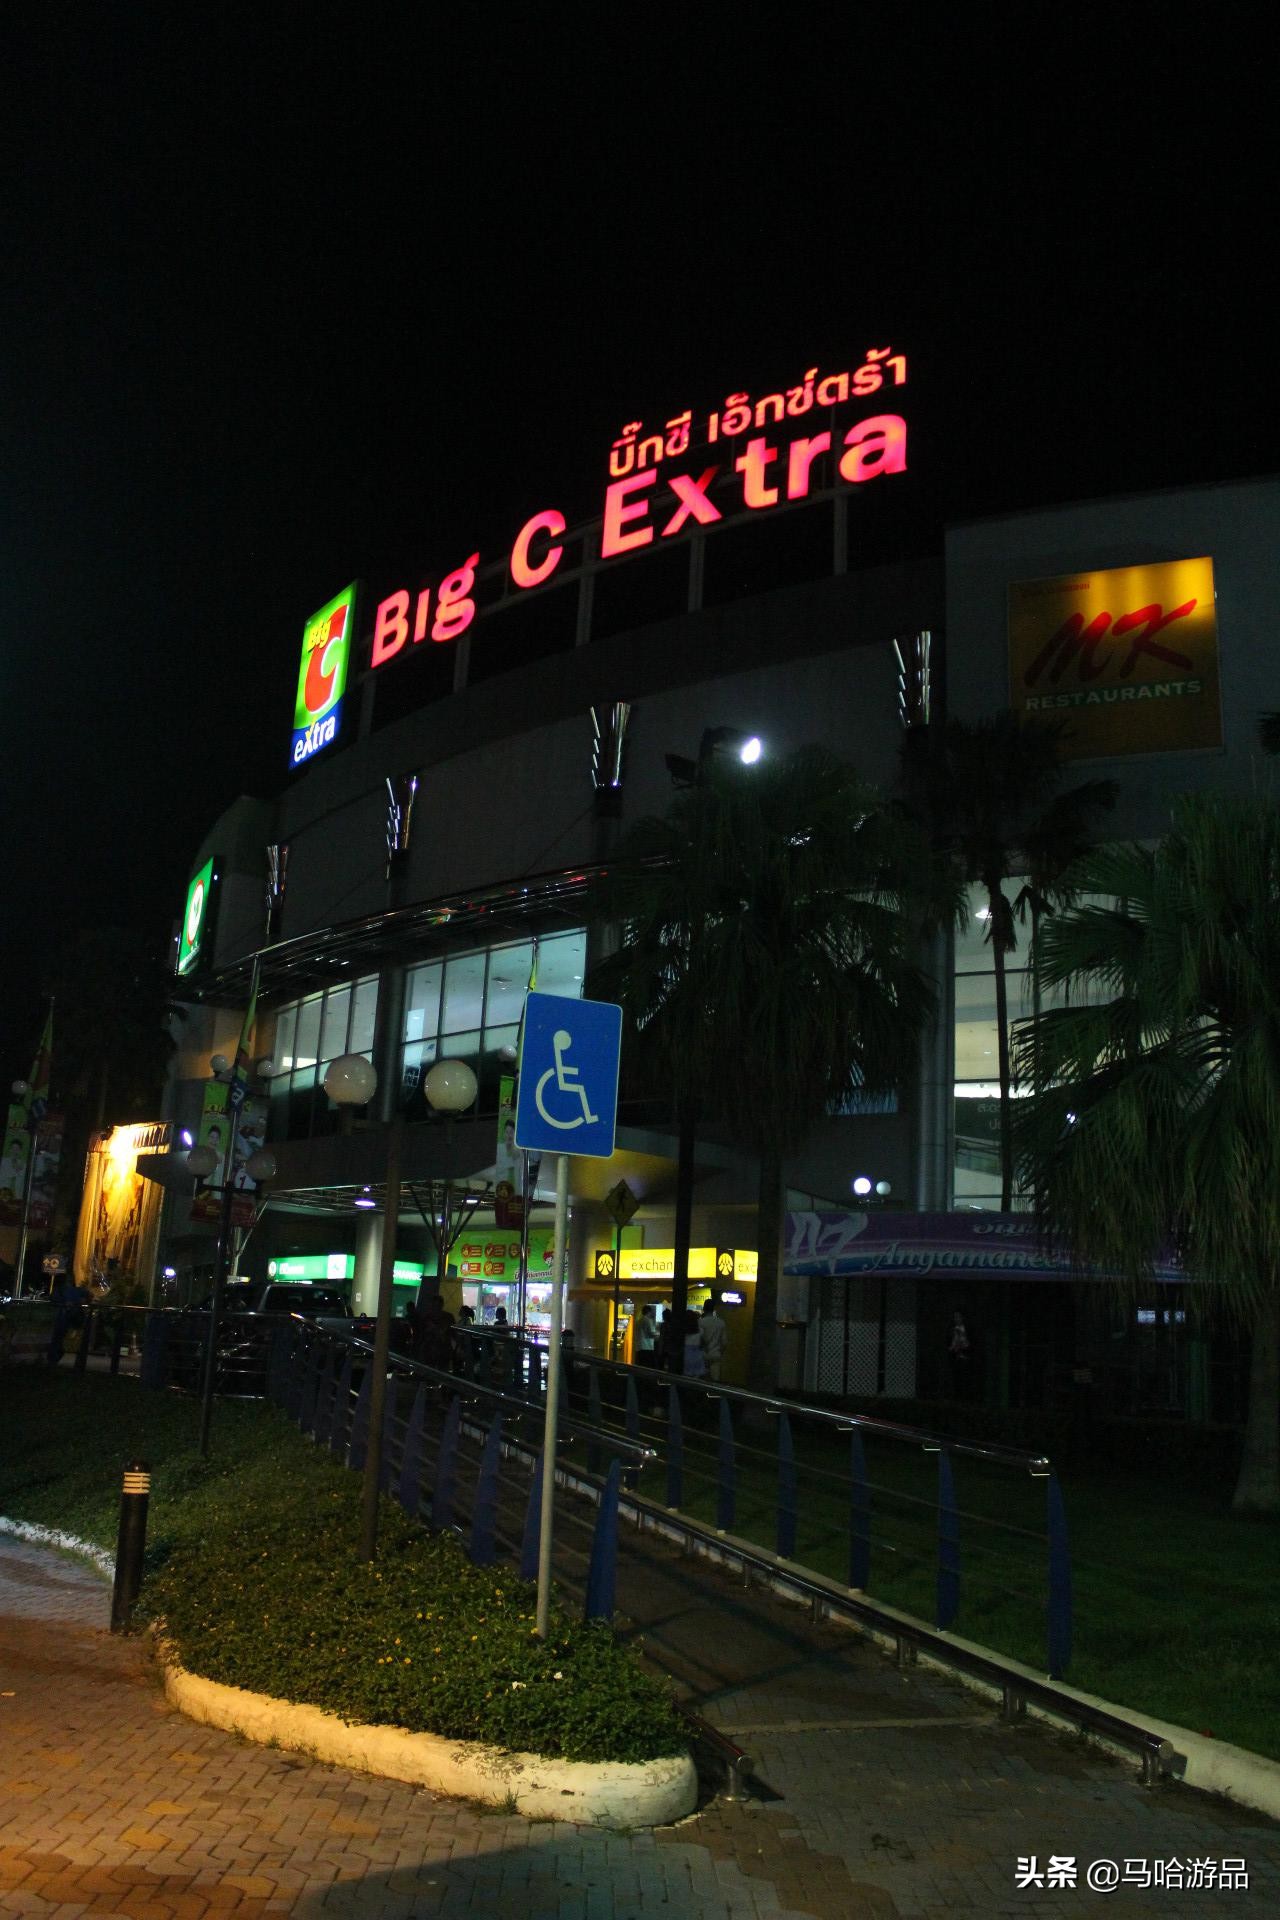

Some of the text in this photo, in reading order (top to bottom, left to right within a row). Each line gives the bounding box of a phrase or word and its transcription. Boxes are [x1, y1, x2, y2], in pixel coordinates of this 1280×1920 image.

[370, 413, 907, 669] Big C Extra
[1024, 598, 1198, 688] MK
[1025, 680, 1202, 711] RESTAURANTS
[631, 1258, 674, 1272] exchan
